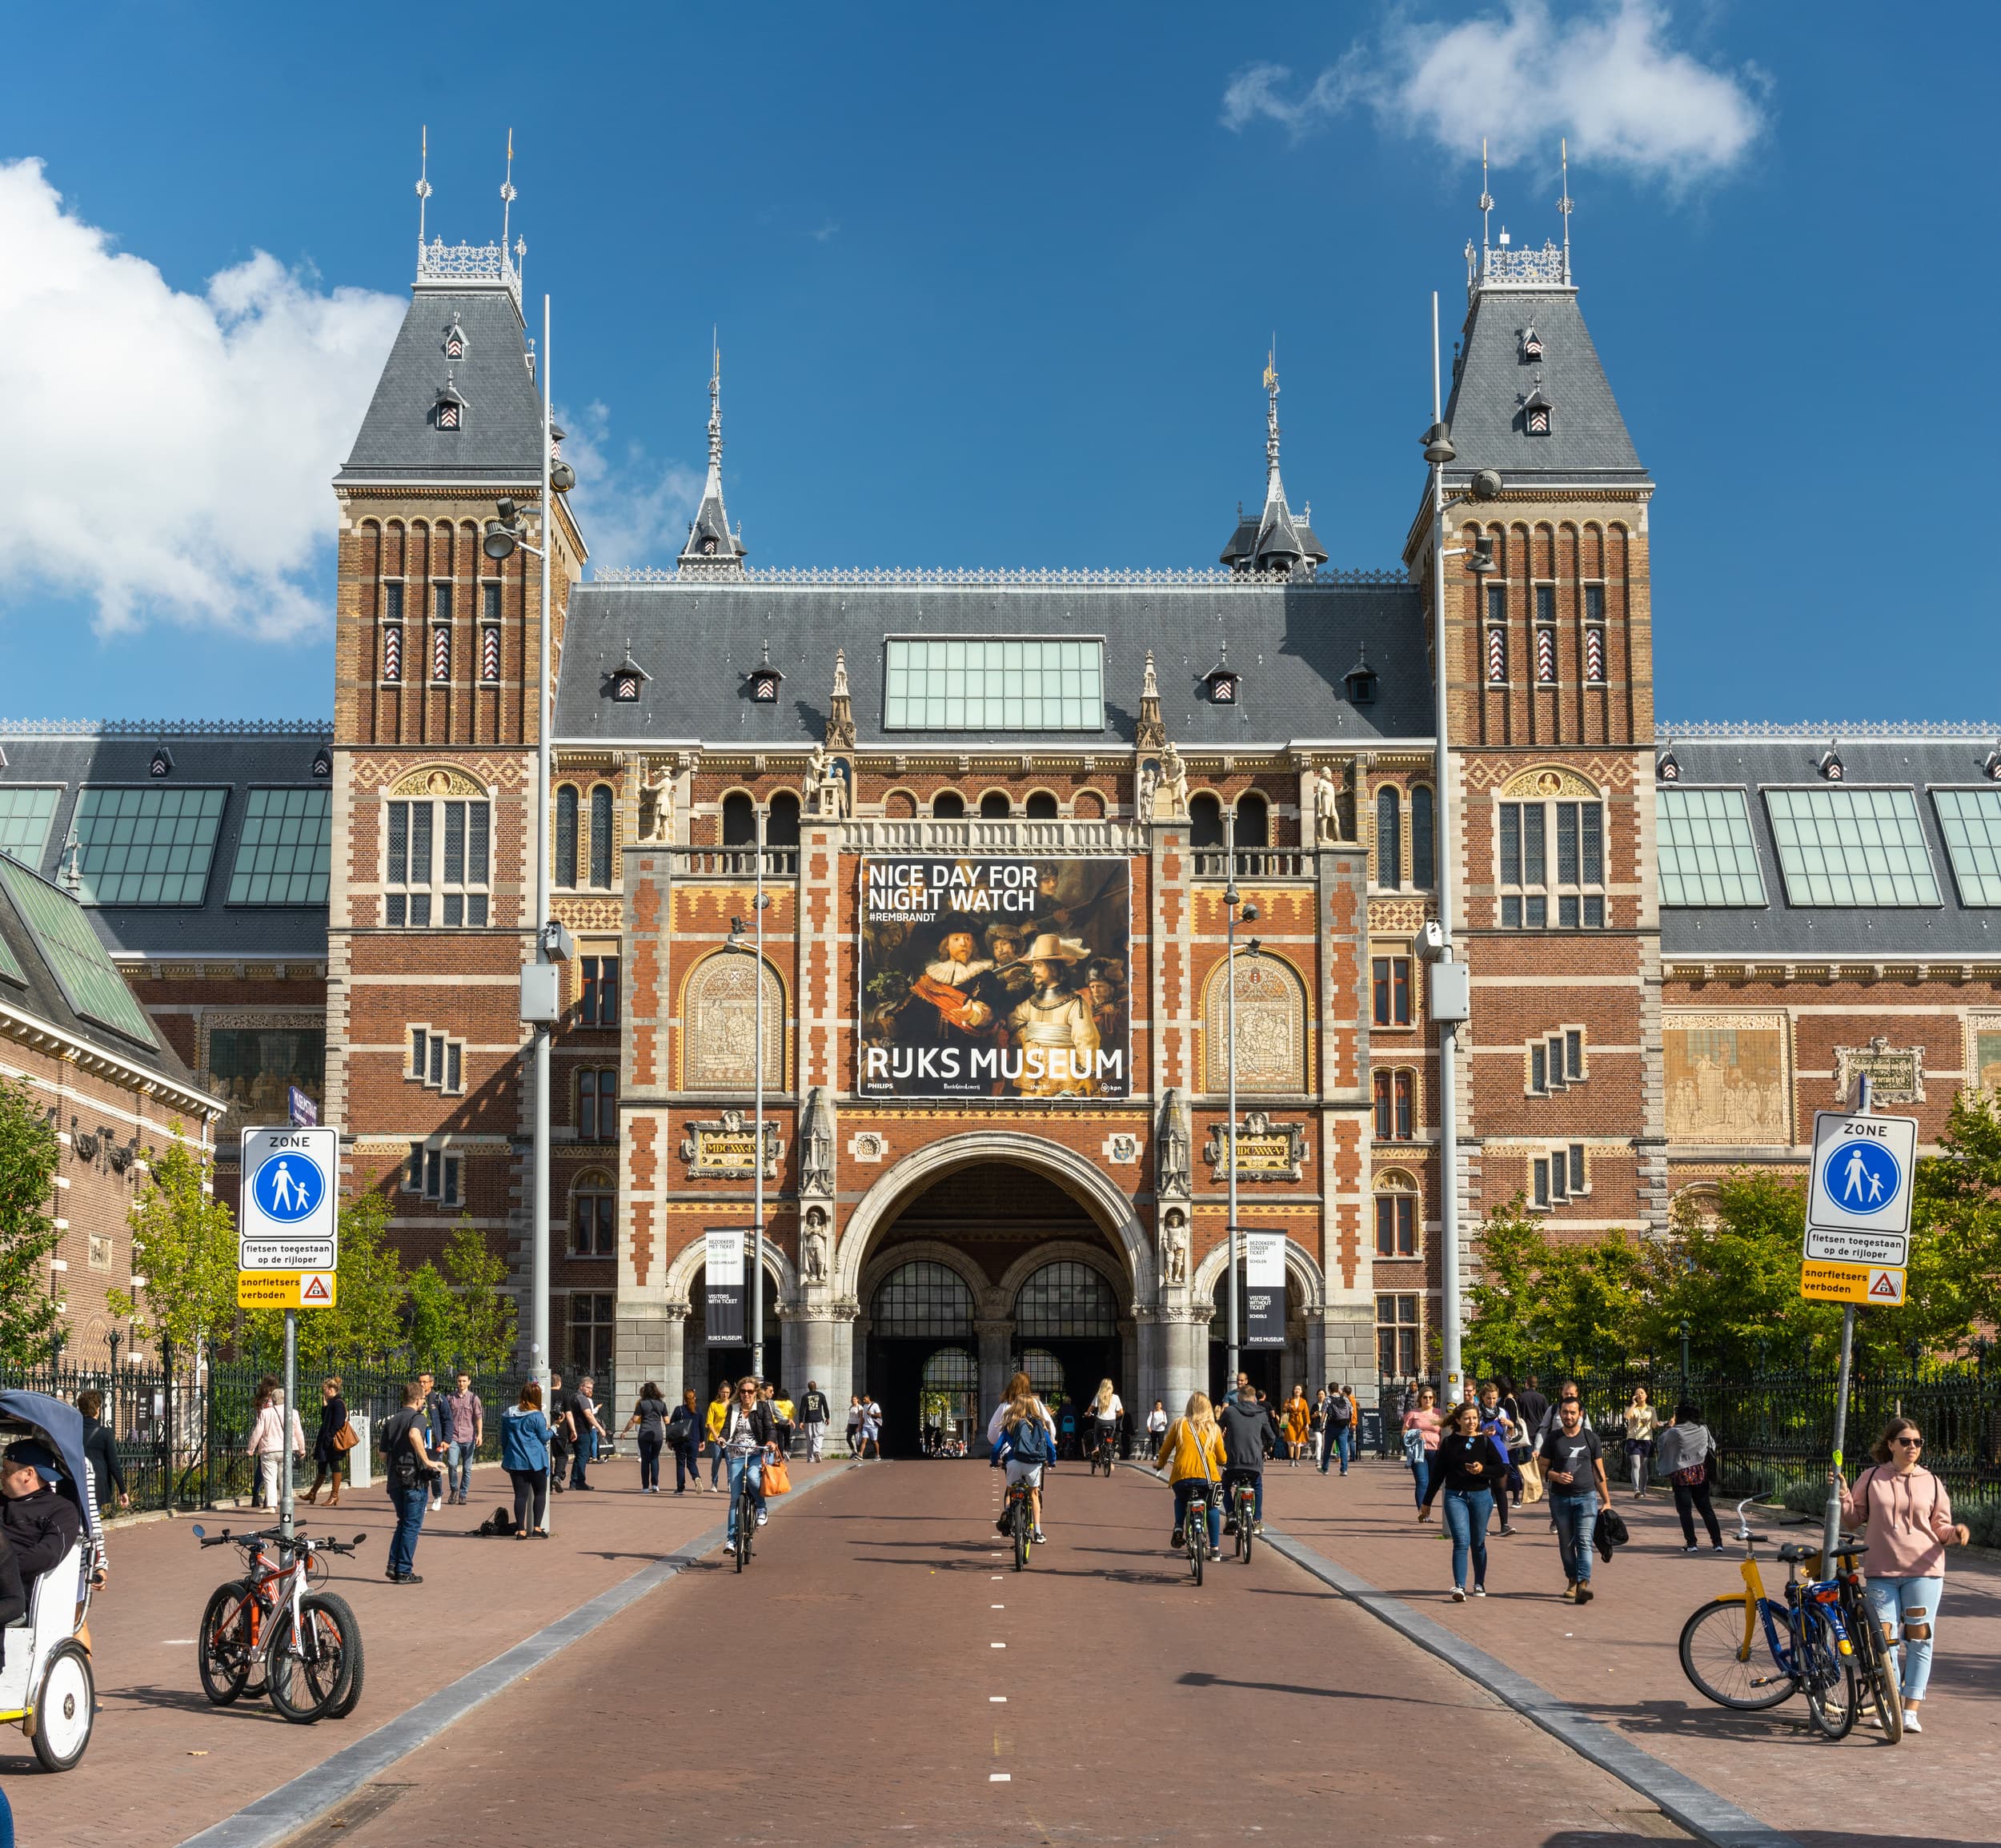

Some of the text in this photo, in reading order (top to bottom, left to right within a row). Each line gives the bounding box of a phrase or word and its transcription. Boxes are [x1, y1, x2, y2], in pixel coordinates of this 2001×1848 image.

[868, 864, 1038, 888] NICE DAY FOR
[868, 888, 1035, 912] NIGHT WATCH
[868, 912, 936, 922] #REMBRANDT
[867, 1048, 1122, 1080] RIJKS MUSEUM
[1844, 1124, 1887, 1137] ZONE
[270, 1136, 311, 1148] ZONE
[1812, 1233, 1902, 1249] fietsen toegestaan
[246, 1245, 330, 1255] fietsen toegestaan
[1824, 1247, 1888, 1260] op de rijloper
[258, 1255, 317, 1265] op de rijloper
[1805, 1269, 1867, 1281] snorfietsers
[241, 1278, 300, 1286] snorfietsers
[1804, 1283, 1851, 1294] verboden
[241, 1291, 286, 1299] verboden
